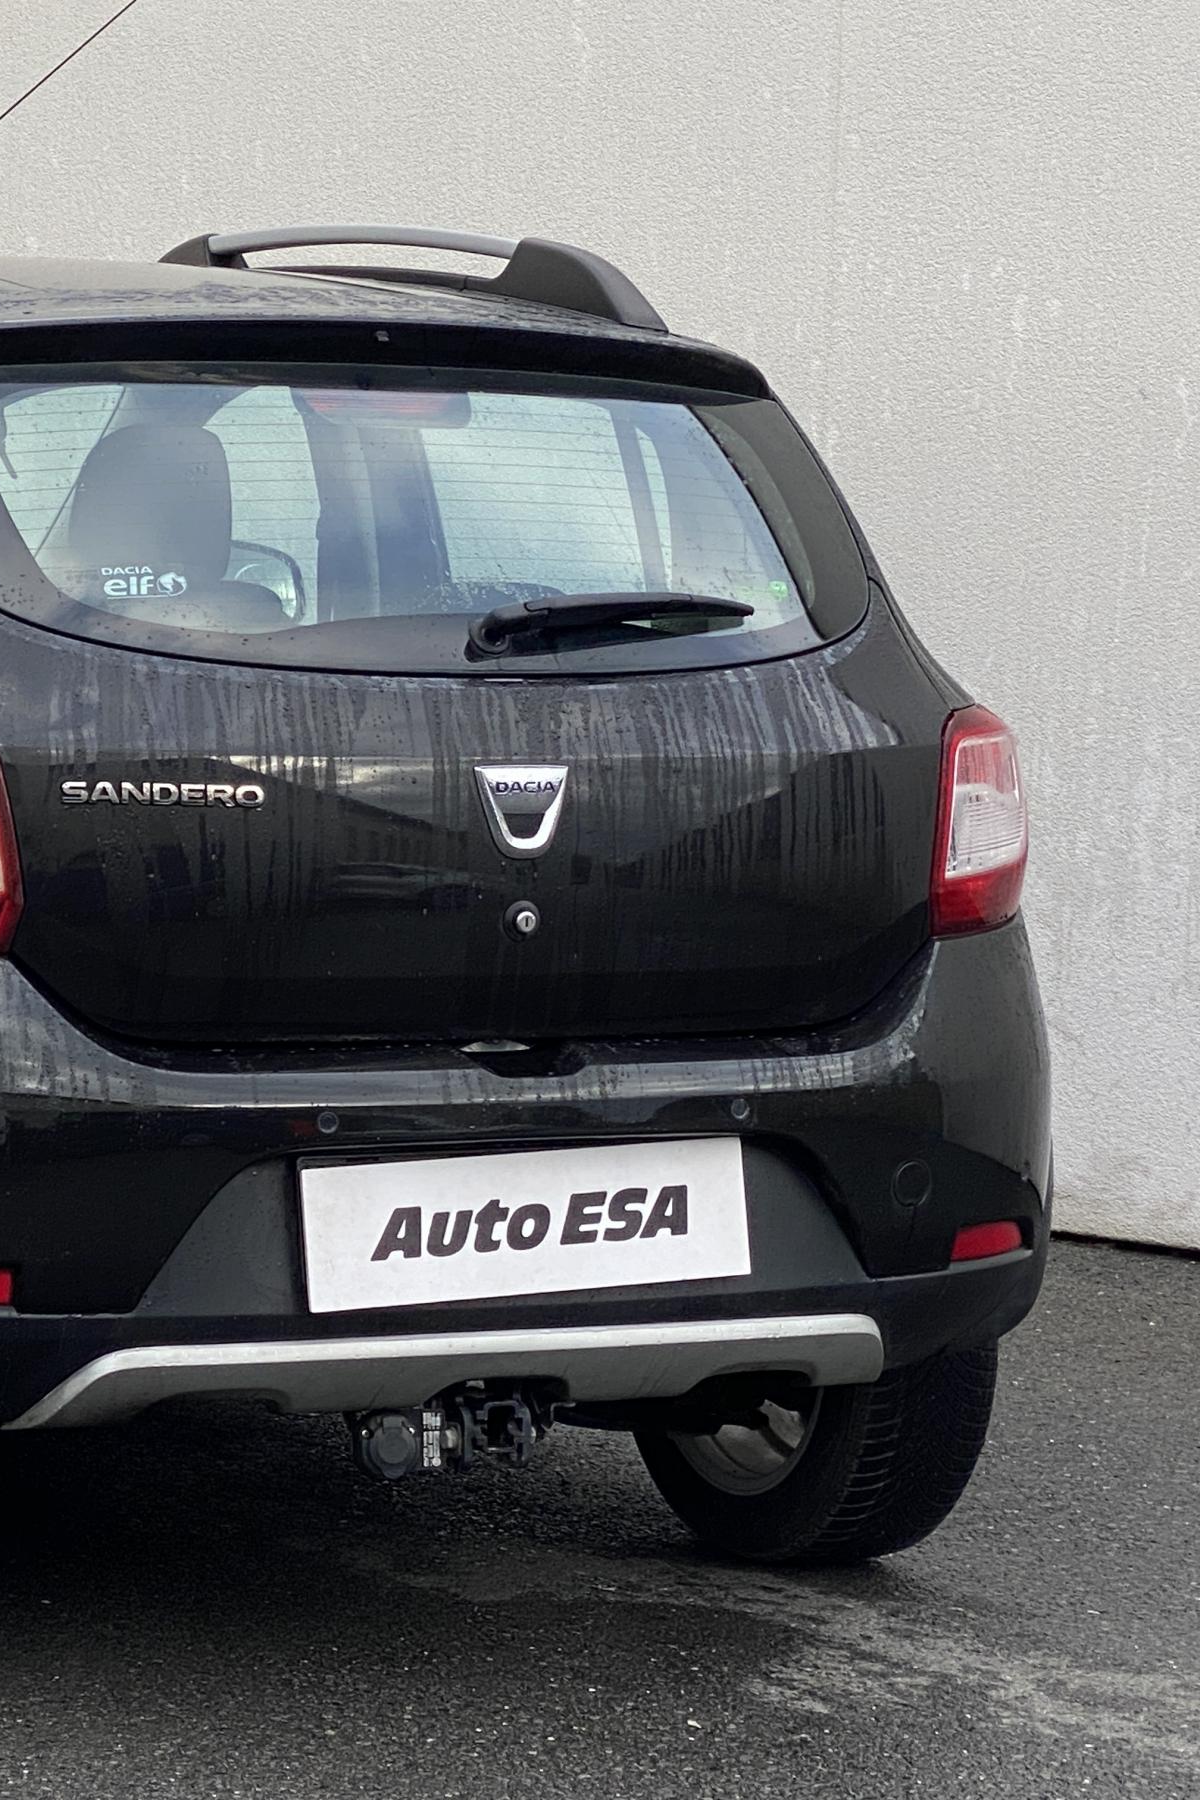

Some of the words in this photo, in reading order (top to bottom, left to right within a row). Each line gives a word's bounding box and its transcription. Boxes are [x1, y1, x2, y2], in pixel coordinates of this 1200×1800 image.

[101, 566, 152, 575] DACIA
[104, 576, 154, 595] elf
[60, 781, 265, 808] SANDERO
[496, 781, 555, 793] DACIA
[371, 1199, 550, 1261] Auto
[560, 1184, 688, 1245] ESA
